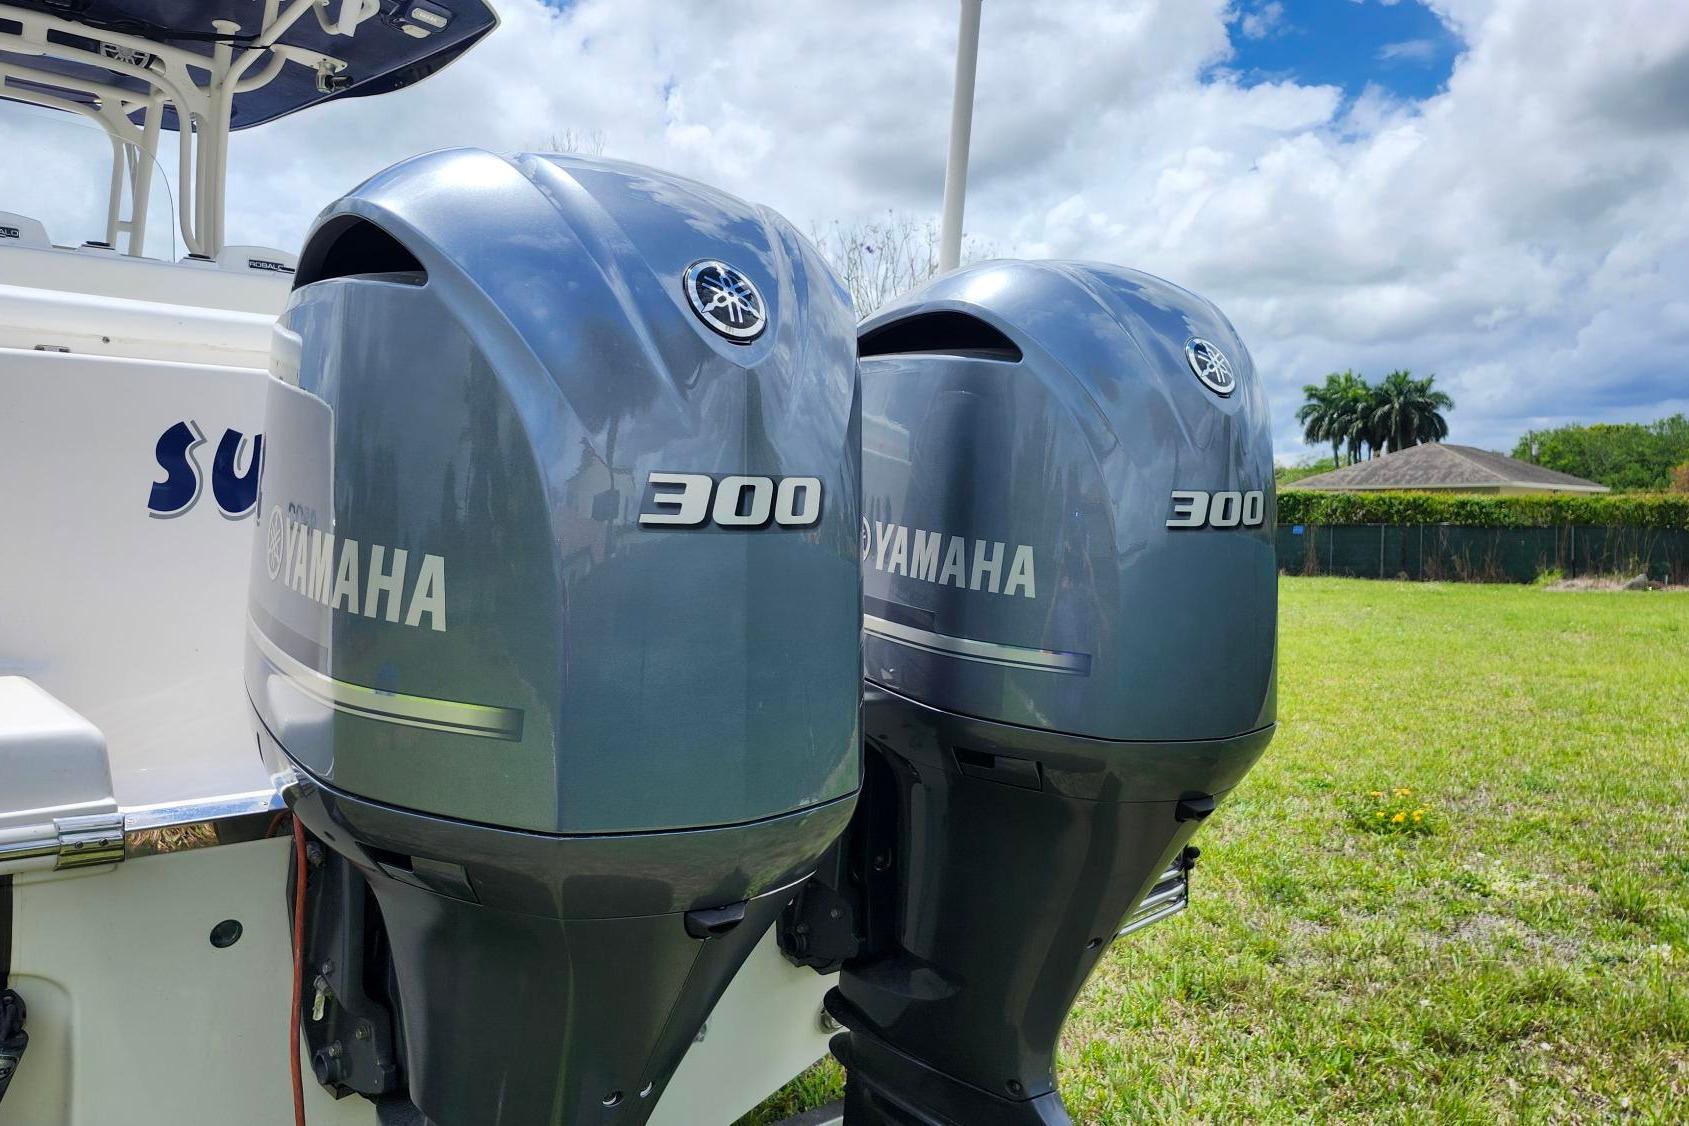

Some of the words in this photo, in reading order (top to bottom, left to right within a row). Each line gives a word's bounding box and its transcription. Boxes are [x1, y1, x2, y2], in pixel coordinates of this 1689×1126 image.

[639, 472, 823, 528] 300
[1166, 489, 1265, 530] 300
[283, 519, 446, 633] YAMAHA
[875, 520, 1036, 599] YAMAHA
